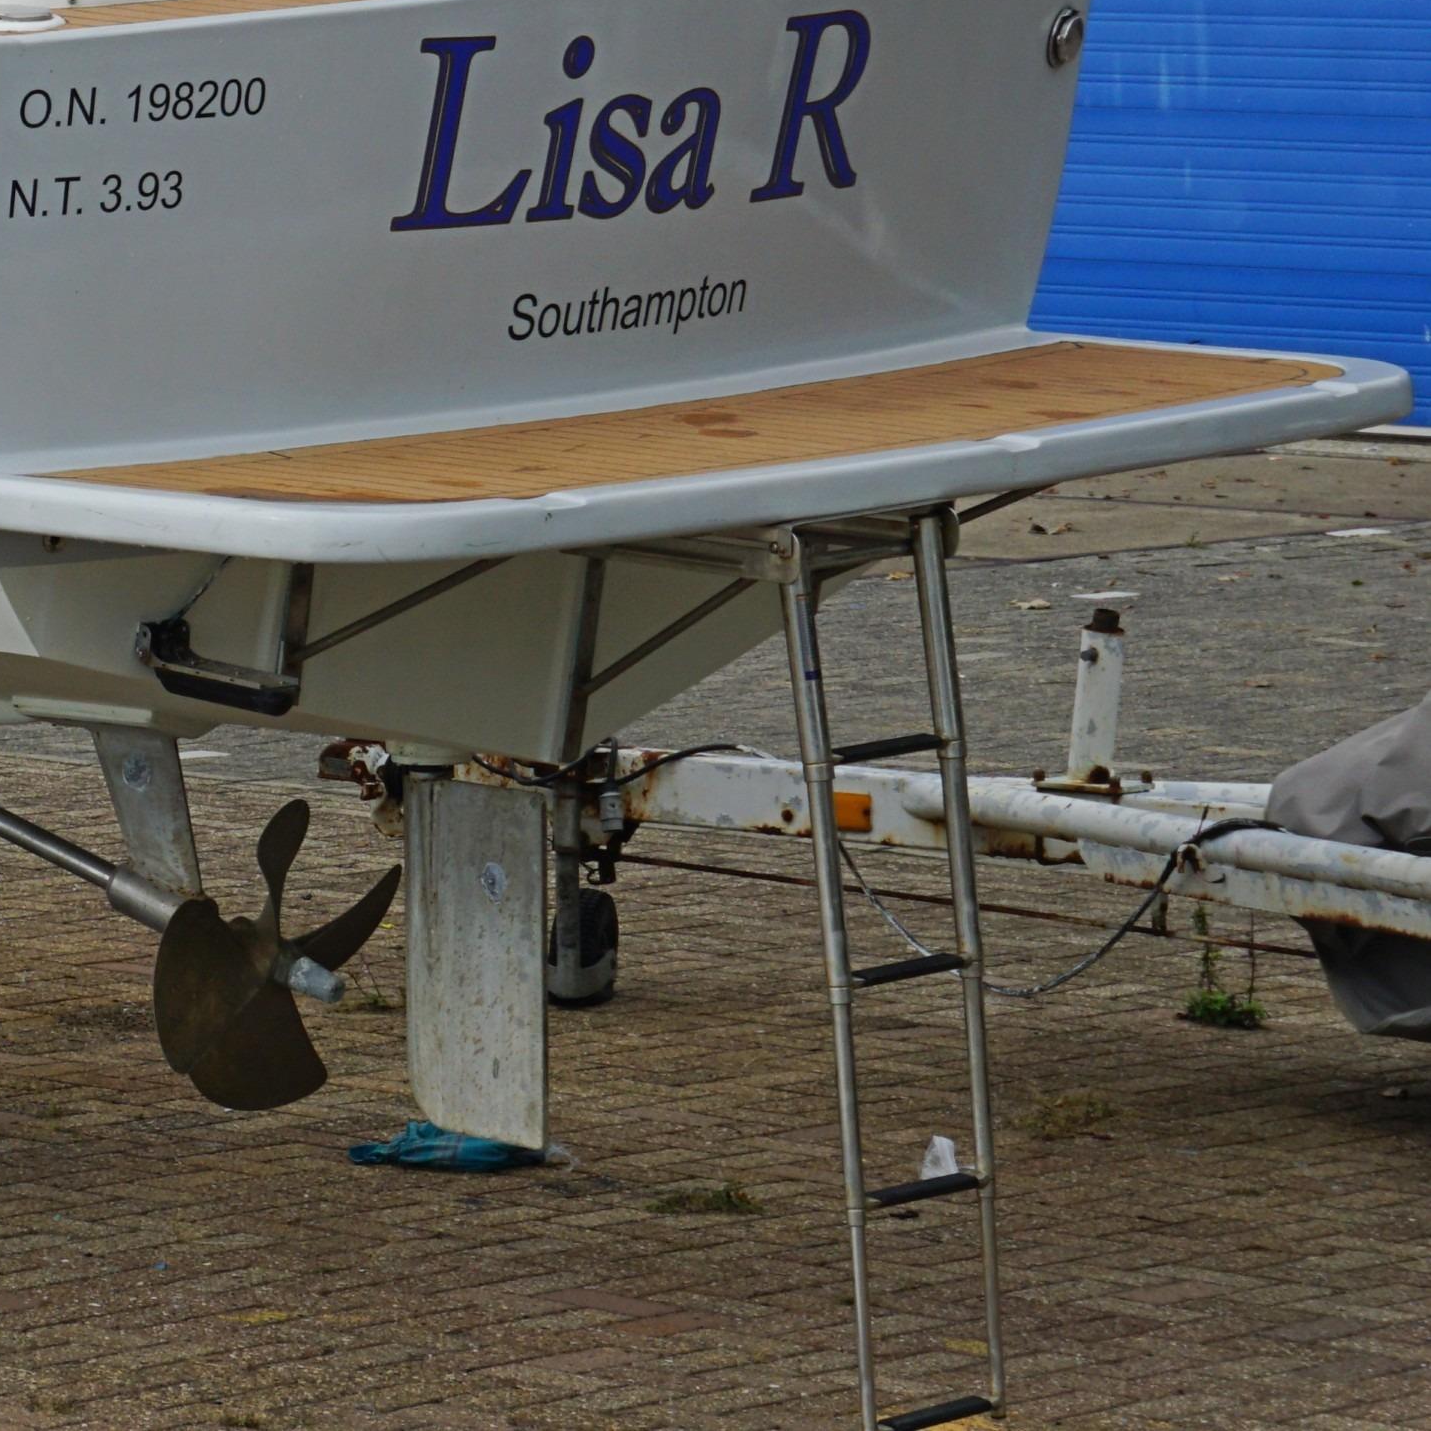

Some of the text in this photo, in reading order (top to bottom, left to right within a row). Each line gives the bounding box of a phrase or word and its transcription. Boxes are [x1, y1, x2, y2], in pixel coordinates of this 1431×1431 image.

[20, 78, 265, 128] O.N. 198200
[390, 10, 871, 232] Lisa R
[9, 171, 182, 218] N.T. 3.93
[508, 276, 746, 340] Southampton
